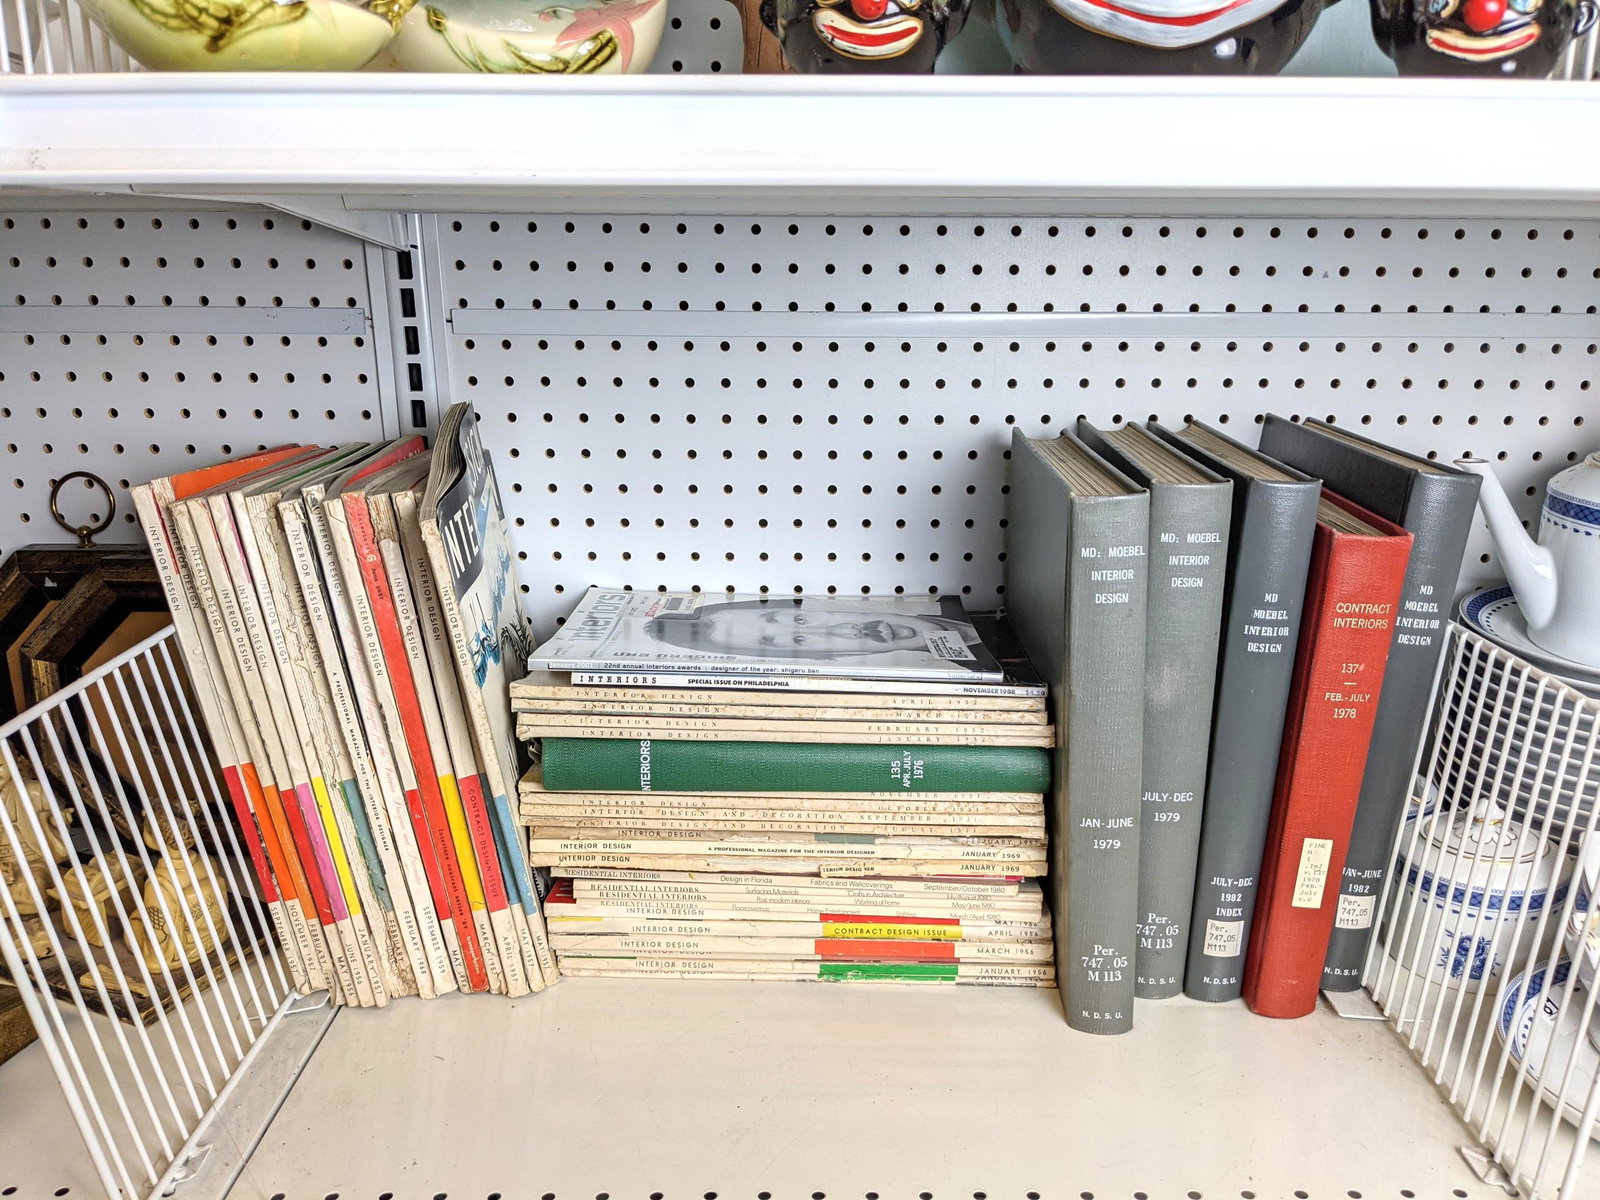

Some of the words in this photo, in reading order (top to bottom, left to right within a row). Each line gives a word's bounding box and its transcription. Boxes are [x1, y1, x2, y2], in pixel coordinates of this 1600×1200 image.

[1161, 533, 1179, 543] MD:
[1187, 533, 1221, 543] MOEBEL
[316, 513, 332, 558] INTERIOR
[329, 562, 343, 597] DESIGN
[1082, 548, 1101, 558] MD:
[1109, 546, 1145, 557] MOEBEL
[1169, 556, 1209, 565] INTERIOR
[149, 526, 168, 571] INTERIOR
[164, 576, 180, 611] DESIGN
[169, 524, 186, 569] INTERIOR
[183, 574, 199, 609] DESIGN
[291, 529, 310, 577] INTERIOR
[307, 584, 322, 621] DESIGN
[1092, 569, 1134, 581] INTERIOR
[1171, 577, 1203, 587] DESIGN
[190, 546, 210, 592] INTERIOR
[206, 597, 223, 633] DESIGN
[1420, 585, 1433, 594] MD
[418, 558, 432, 602] INTERIOR
[428, 607, 441, 641] DESIGN
[1095, 593, 1129, 603] DESIGN
[1264, 593, 1278, 602] MD
[1336, 603, 1392, 614] CONTRACT
[1404, 601, 1438, 612] MOEBEL
[394, 578, 410, 621] INTERIOR
[406, 626, 419, 659] DESIGN
[1253, 610, 1288, 620] MOEBEL
[238, 584, 257, 630] INTERIOR
[253, 633, 268, 668] DESIGN
[260, 580, 276, 625] INTERIOR
[274, 629, 288, 664] DESIGN
[442, 586, 458, 630] INTERIOR
[454, 633, 468, 666] DESIGN
[1334, 618, 1388, 629] INTERIORS
[1396, 617, 1440, 628] INTERIOR
[221, 589, 241, 633] INTERIOR
[237, 637, 252, 672] DESIGN
[356, 595, 372, 638] INTERIOR
[369, 642, 382, 676] DESIGN
[1244, 625, 1289, 636] INTERIOR
[1398, 636, 1431, 645] DESIGN
[1247, 643, 1282, 652] DESIGN
[711, 665, 740, 673] designer
[1333, 709, 1356, 718] 1978
[640, 740, 651, 791] NTERIORS
[891, 760, 900, 779] 135
[914, 760, 923, 778] 1976
[1142, 792, 1194, 802] JULY-DEC
[1154, 813, 1180, 822] 1979
[469, 789, 485, 836] CONTRACT
[480, 840, 492, 872] DESIGN
[489, 875, 498, 897] ISSUE
[1093, 840, 1121, 849] 1979
[438, 829, 449, 860] Interiors
[447, 864, 458, 892] contract
[848, 881, 893, 889] Wallcoverings
[1211, 877, 1252, 886] JULY-DEC
[1349, 884, 1369, 893] 1982
[1221, 893, 1242, 902] 1982
[1343, 898, 1360, 907] Per.
[1216, 907, 1243, 916] INDEX
[1342, 908, 1368, 916] 747.05
[1147, 913, 1171, 923] Per.
[1340, 918, 1358, 926] M113
[403, 911, 420, 951] FEBRUARY
[1210, 923, 1228, 933] Per.
[271, 907, 290, 952] SEPTEMBER
[288, 956, 298, 973] 1957
[290, 905, 308, 949] NOVEMBER
[306, 954, 315, 970] 1957
[423, 906, 440, 952] SEPTEMBER
[436, 956, 446, 974] 1959
[480, 923, 492, 953] MARCH
[1209, 933, 1236, 943] 747.05
[310, 924, 327, 964] FEBRUARY
[1207, 943, 1226, 952] M113
[536, 935, 544, 950] MAY
[542, 954, 550, 968] 1957
[1094, 945, 1118, 955] Per.
[359, 929, 375, 970] JANUARY
[372, 976, 382, 994] 1957
[452, 950, 462, 967] MAY
[503, 936, 512, 959] APRIL
[510, 964, 519, 982] 1957
[526, 951, 534, 966] 1957
[346, 944, 357, 963] JUNE
[354, 968, 363, 985] 1956
[337, 956, 348, 974] MAY
[345, 979, 355, 996] 1956
